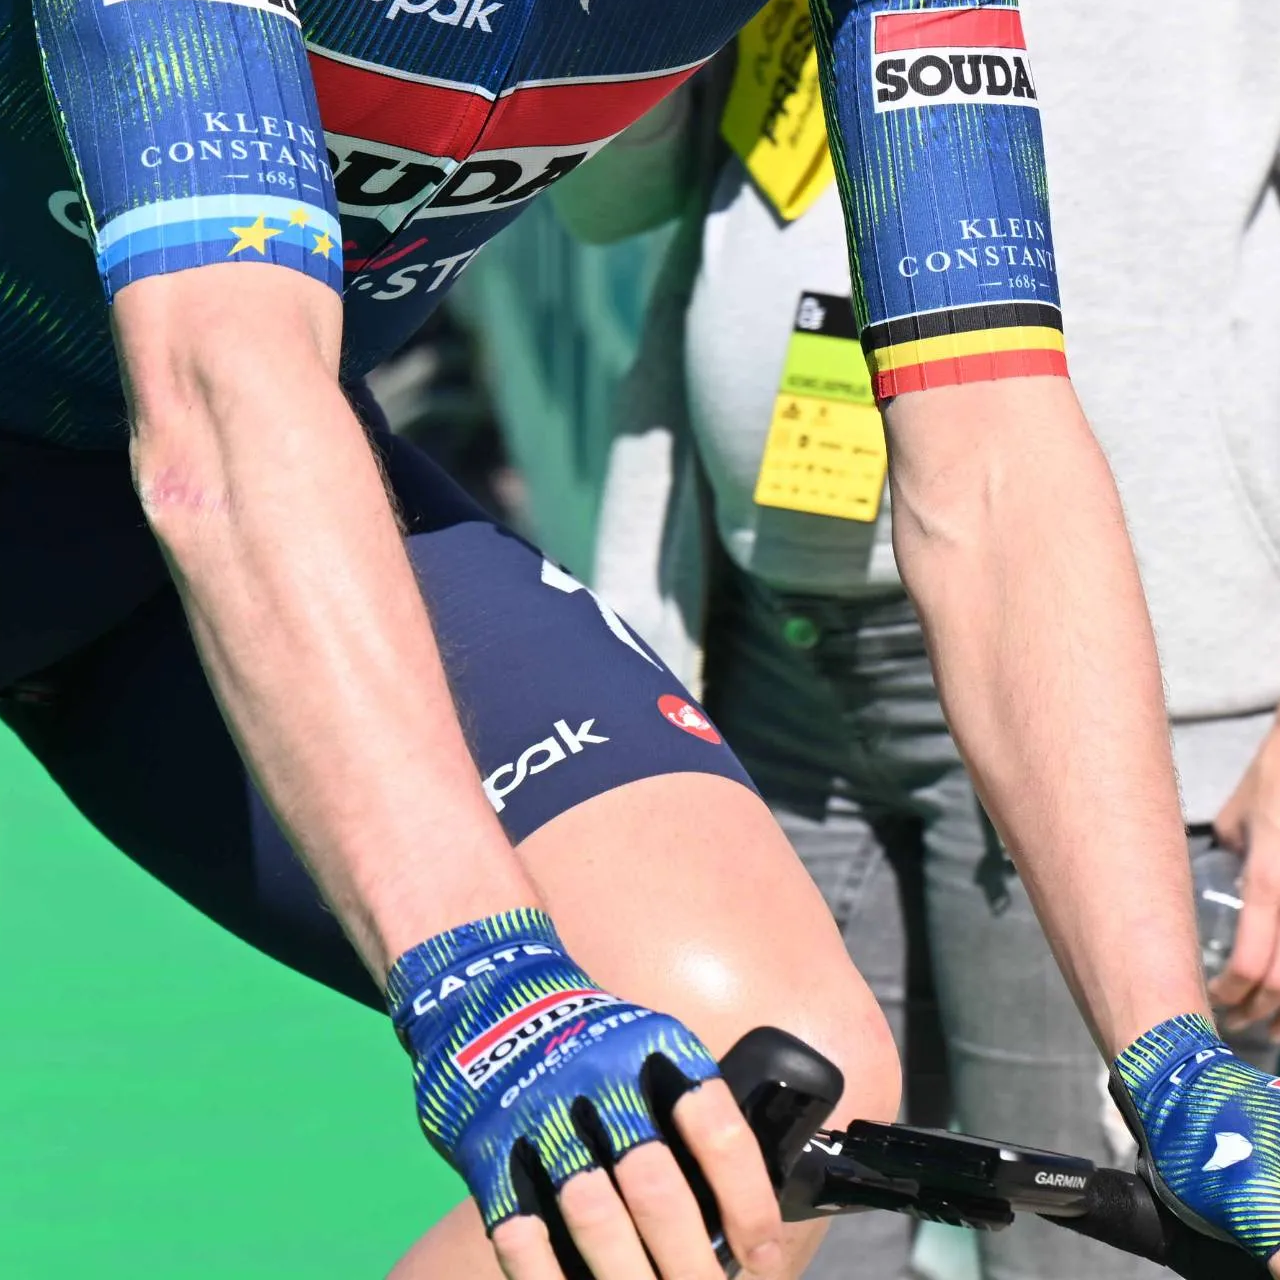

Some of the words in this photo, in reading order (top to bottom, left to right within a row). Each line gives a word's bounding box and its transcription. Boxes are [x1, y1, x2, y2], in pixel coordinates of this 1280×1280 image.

[203, 112, 317, 148] KLEIN
[258, 171, 297, 190] 1685
[960, 217, 1046, 240] KLEIN
[1008, 274, 1037, 292] 1685
[413, 944, 561, 1016] CASTE
[468, 997, 620, 1083] SOUDA
[1034, 1171, 1087, 1189] GARMIN
